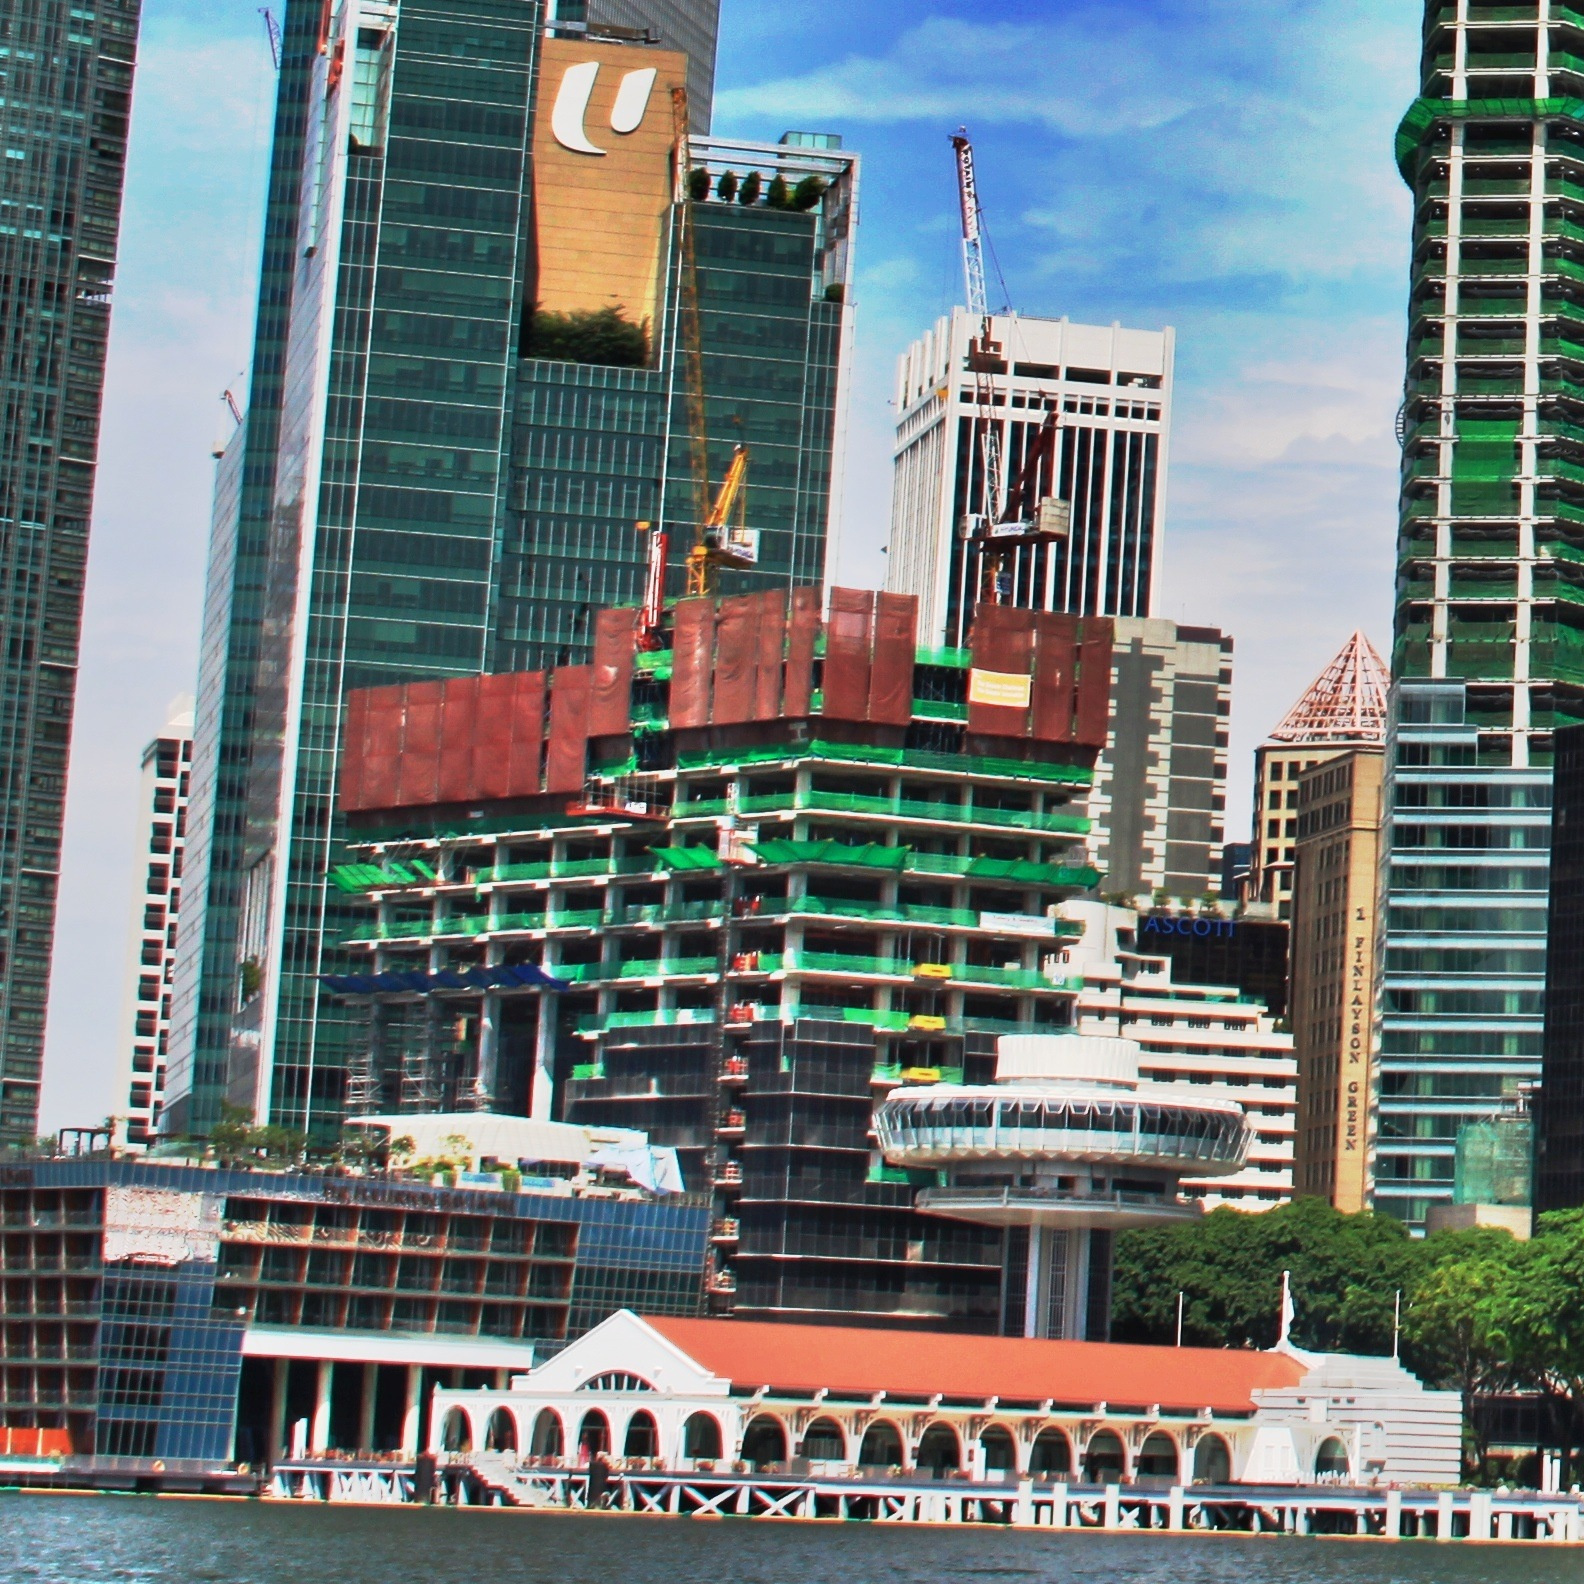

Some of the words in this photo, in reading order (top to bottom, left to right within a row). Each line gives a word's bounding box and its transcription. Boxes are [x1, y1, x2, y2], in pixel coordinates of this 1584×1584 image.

[1144, 916, 1238, 937] ASCOTT
[1355, 907, 1366, 921] 1
[1348, 936, 1365, 1064] FINLAYSON
[1344, 1080, 1359, 1151] GREEN
